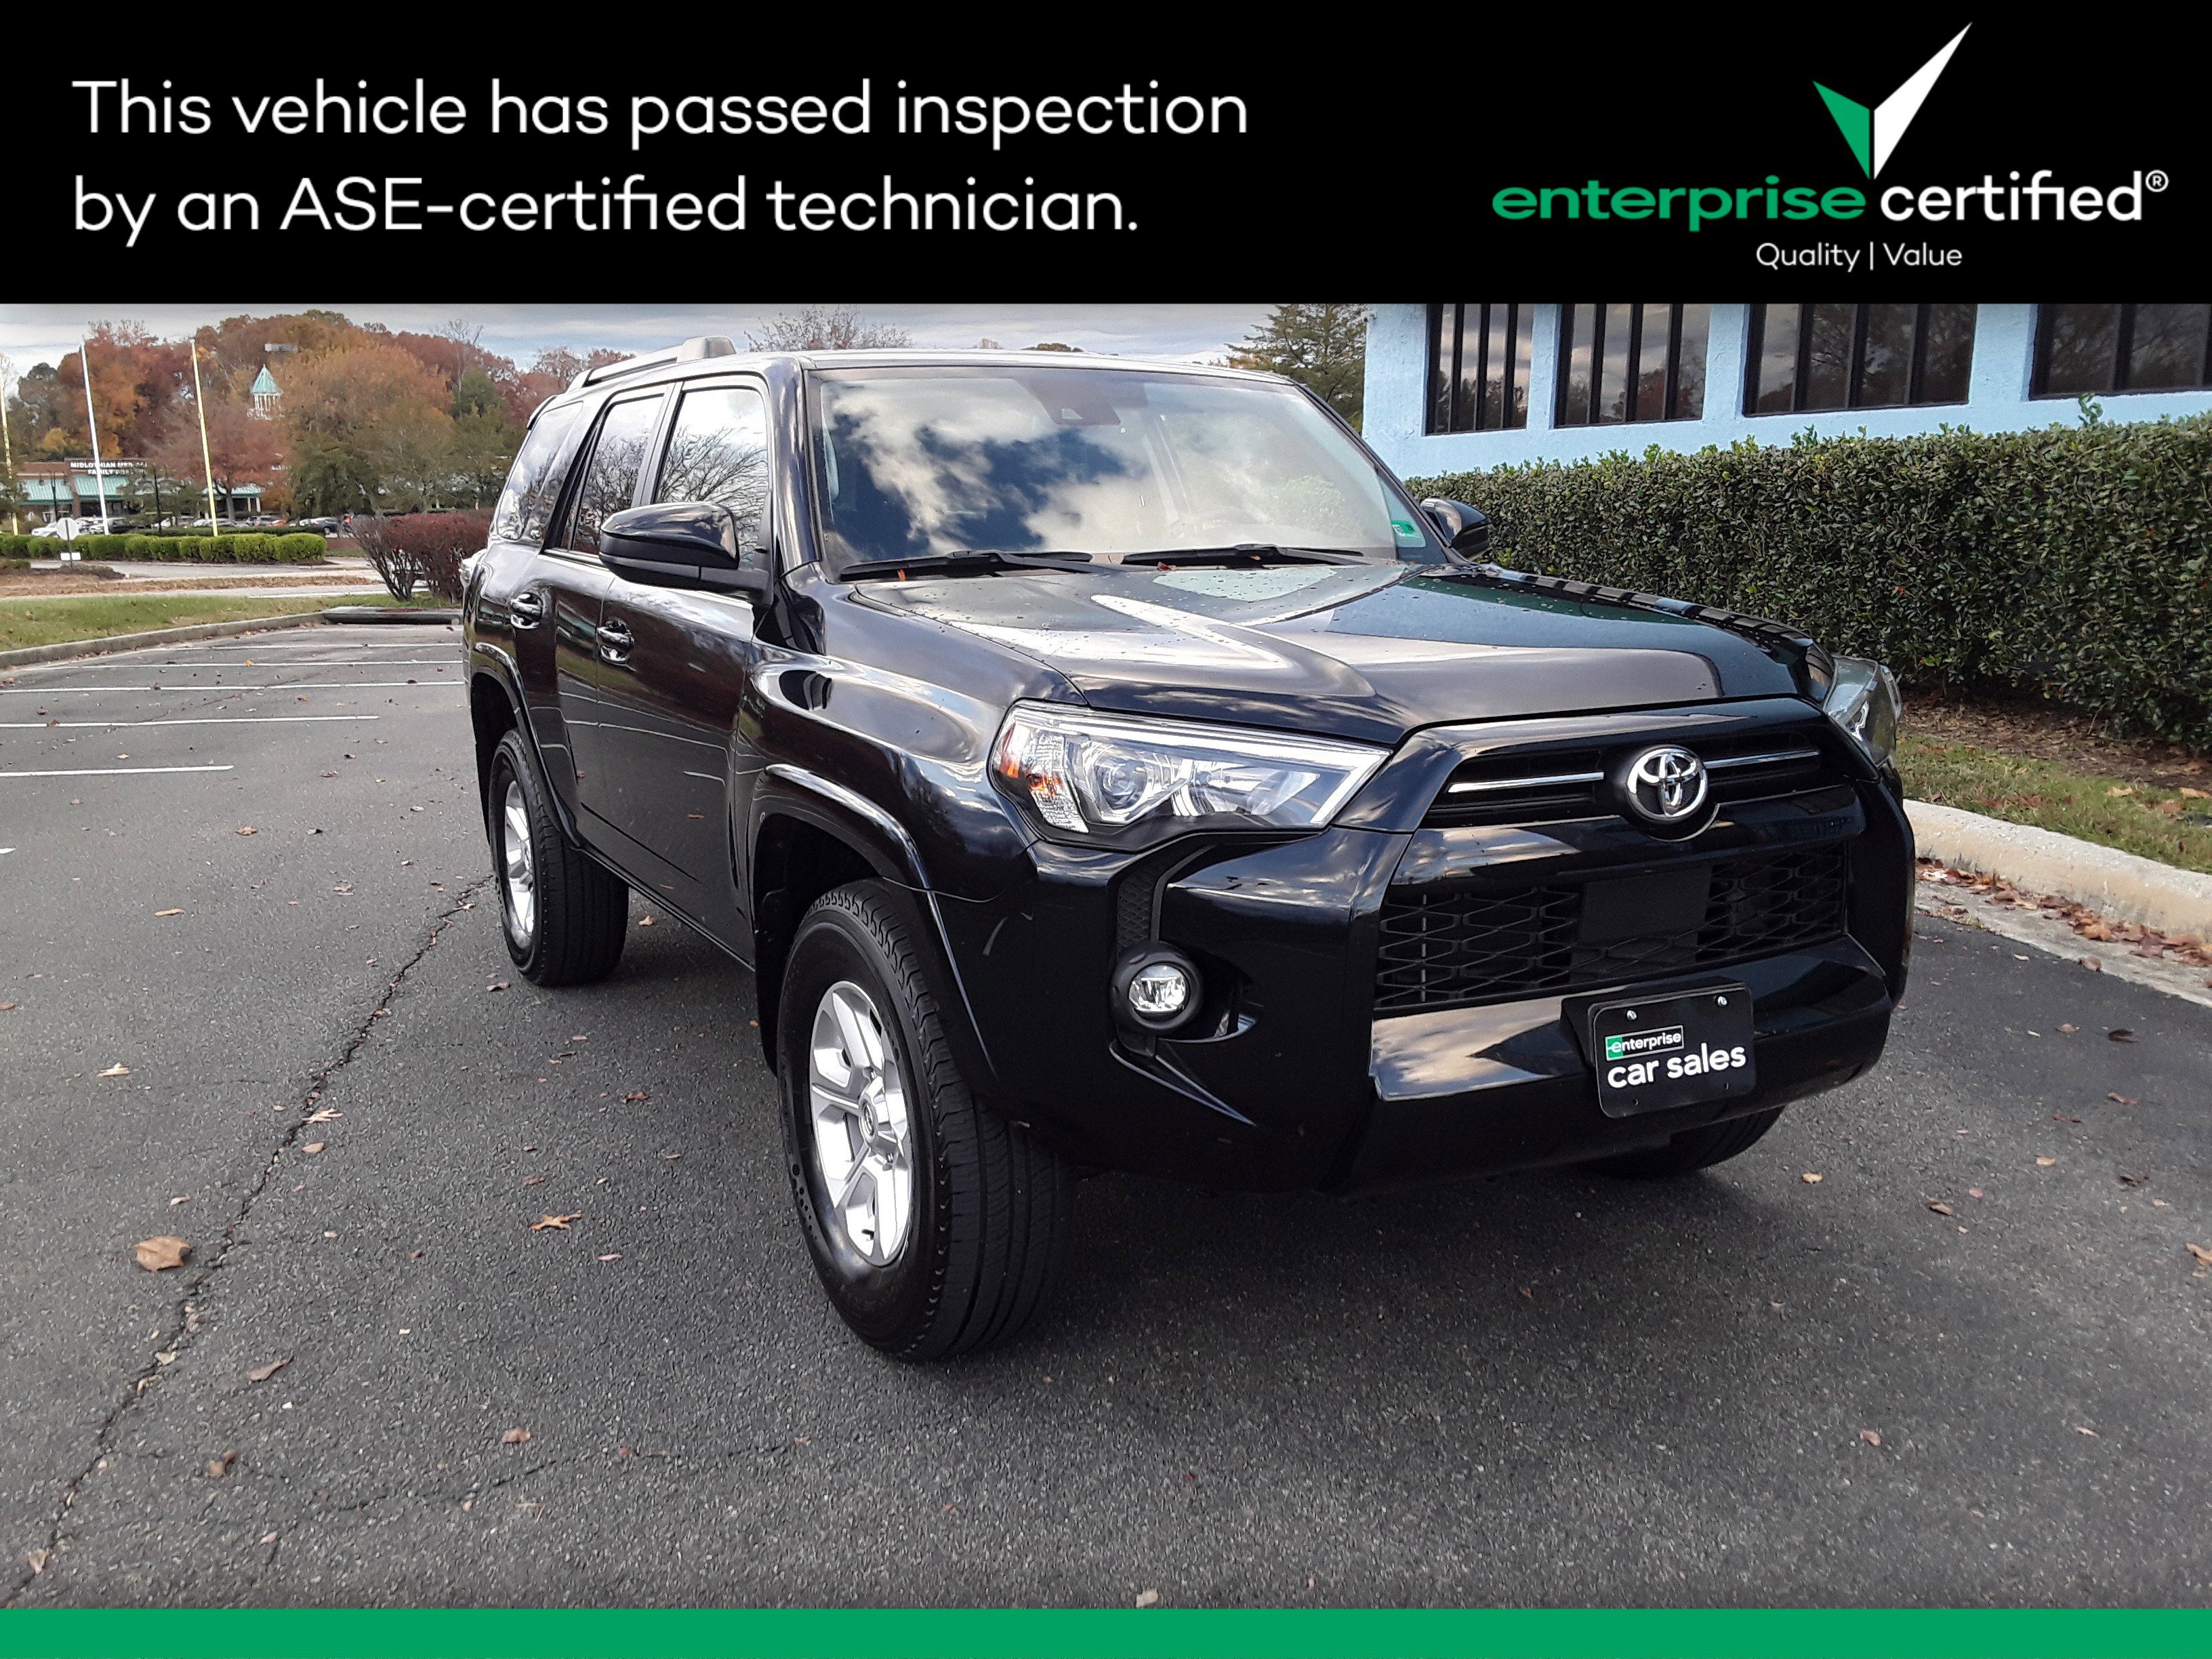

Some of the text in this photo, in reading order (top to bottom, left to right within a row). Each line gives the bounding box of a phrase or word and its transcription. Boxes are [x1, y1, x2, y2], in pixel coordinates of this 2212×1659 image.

[1608, 1032, 1682, 1053] enterprise
[1607, 1042, 1746, 1088] car sales
